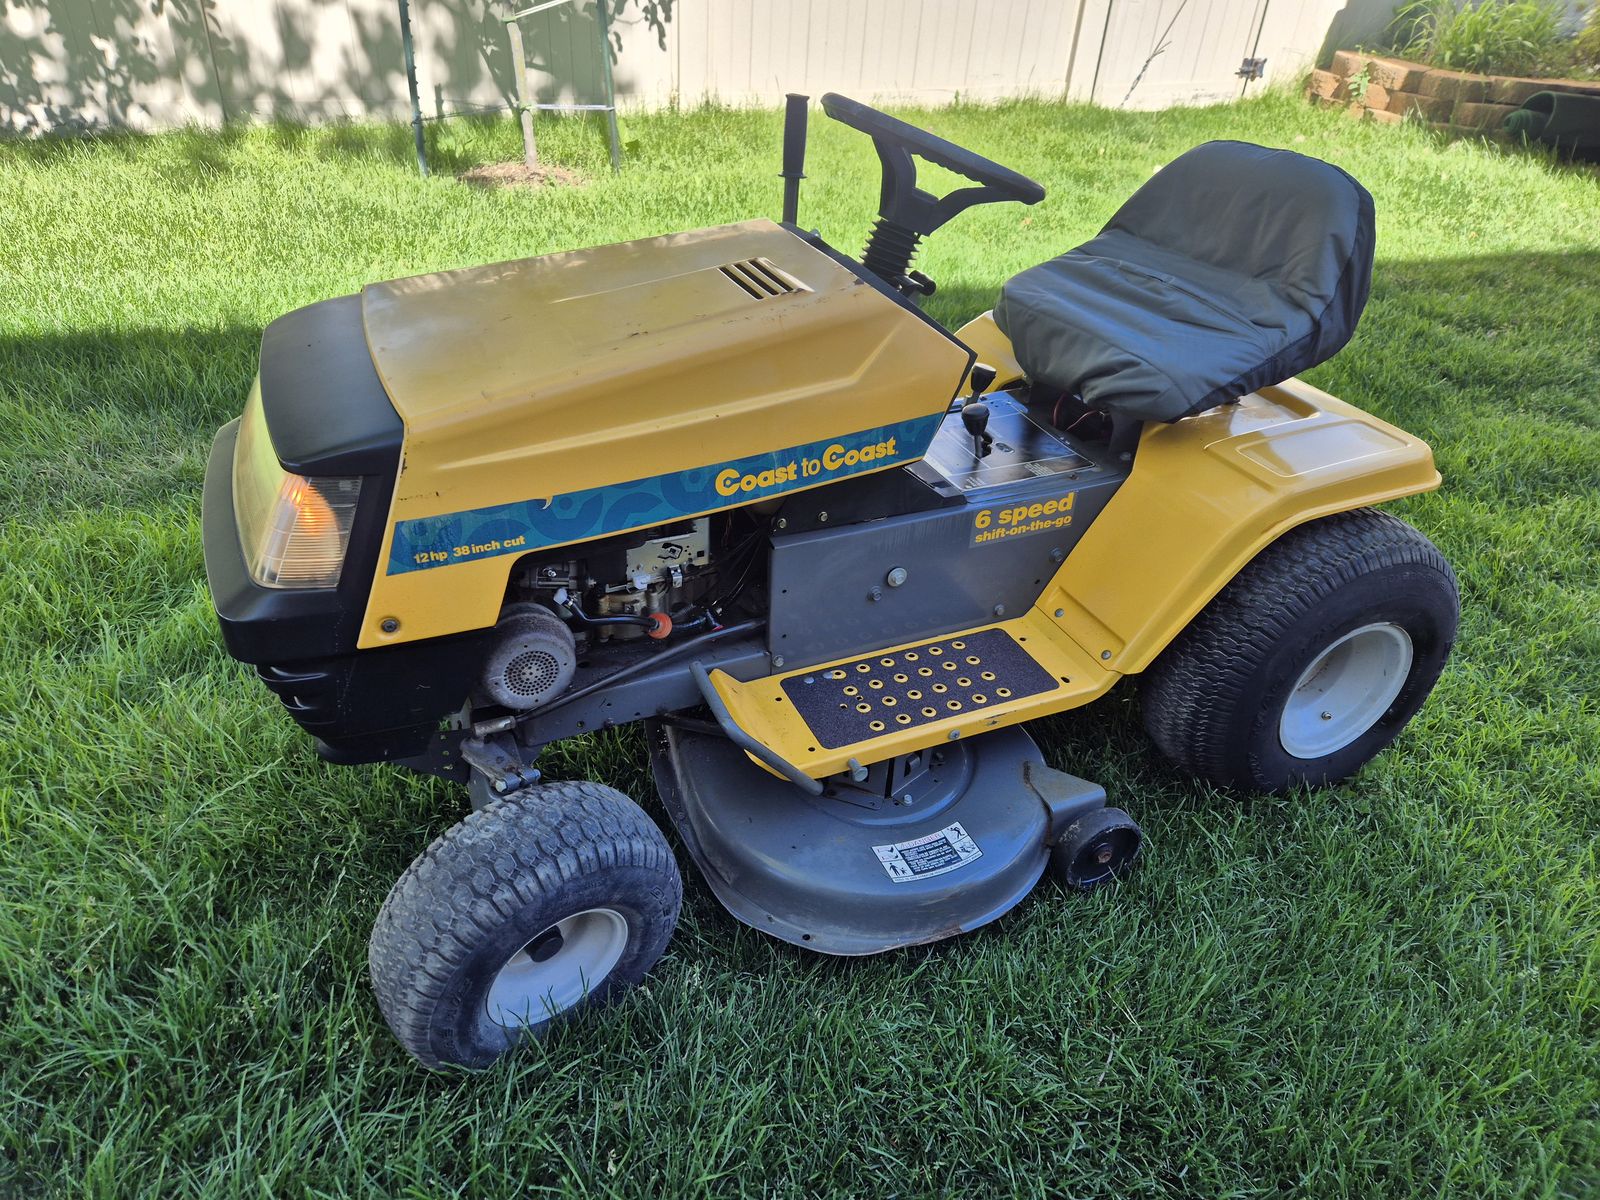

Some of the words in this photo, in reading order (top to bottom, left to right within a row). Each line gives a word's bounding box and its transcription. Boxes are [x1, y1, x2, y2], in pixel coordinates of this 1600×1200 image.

[715, 460, 797, 496] Coast
[801, 457, 821, 477] to
[822, 436, 897, 471] Coast
[975, 510, 992, 529] 6
[998, 492, 1075, 526] speed
[503, 535, 525, 548] cut
[975, 515, 1073, 543] shift-on-the-go
